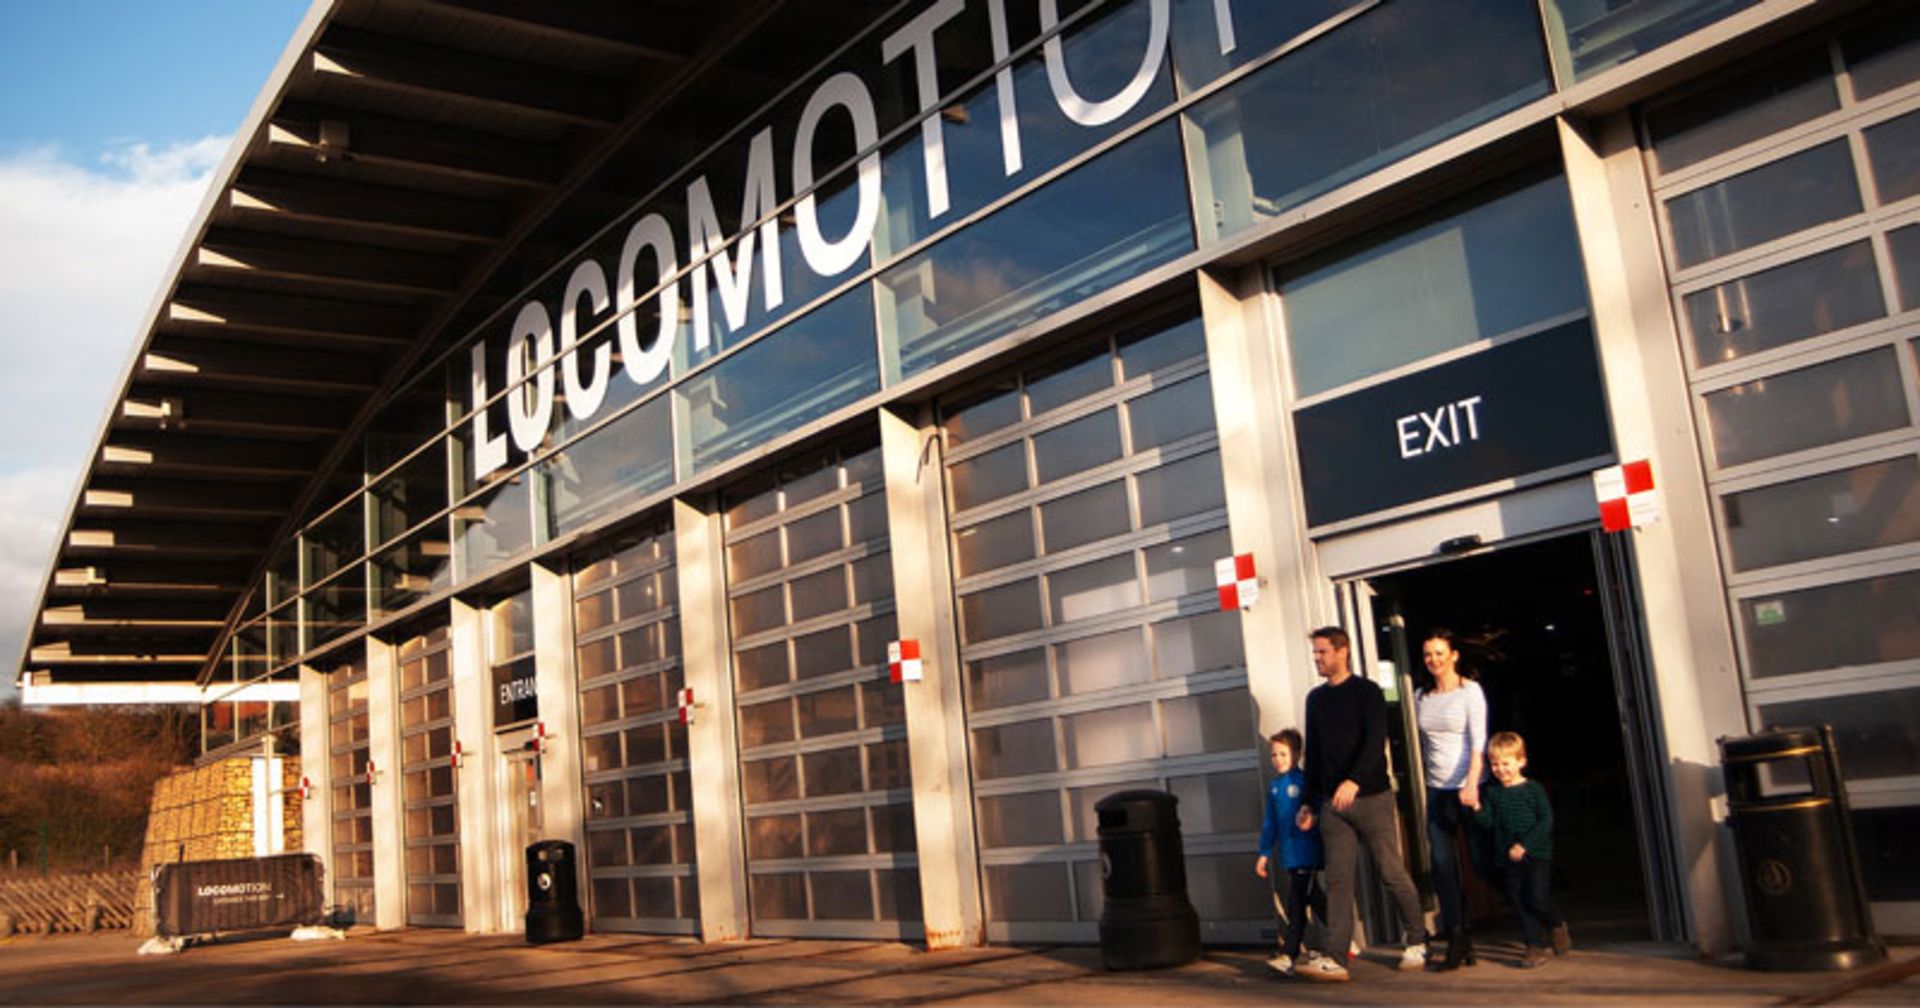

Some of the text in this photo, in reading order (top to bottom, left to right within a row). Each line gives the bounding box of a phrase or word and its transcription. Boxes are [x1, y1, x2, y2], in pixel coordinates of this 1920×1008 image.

[472, 0, 1236, 481] LOCOMOTIO
[1396, 395, 1482, 459] EXIT
[198, 882, 272, 896] LOCOMOTION
